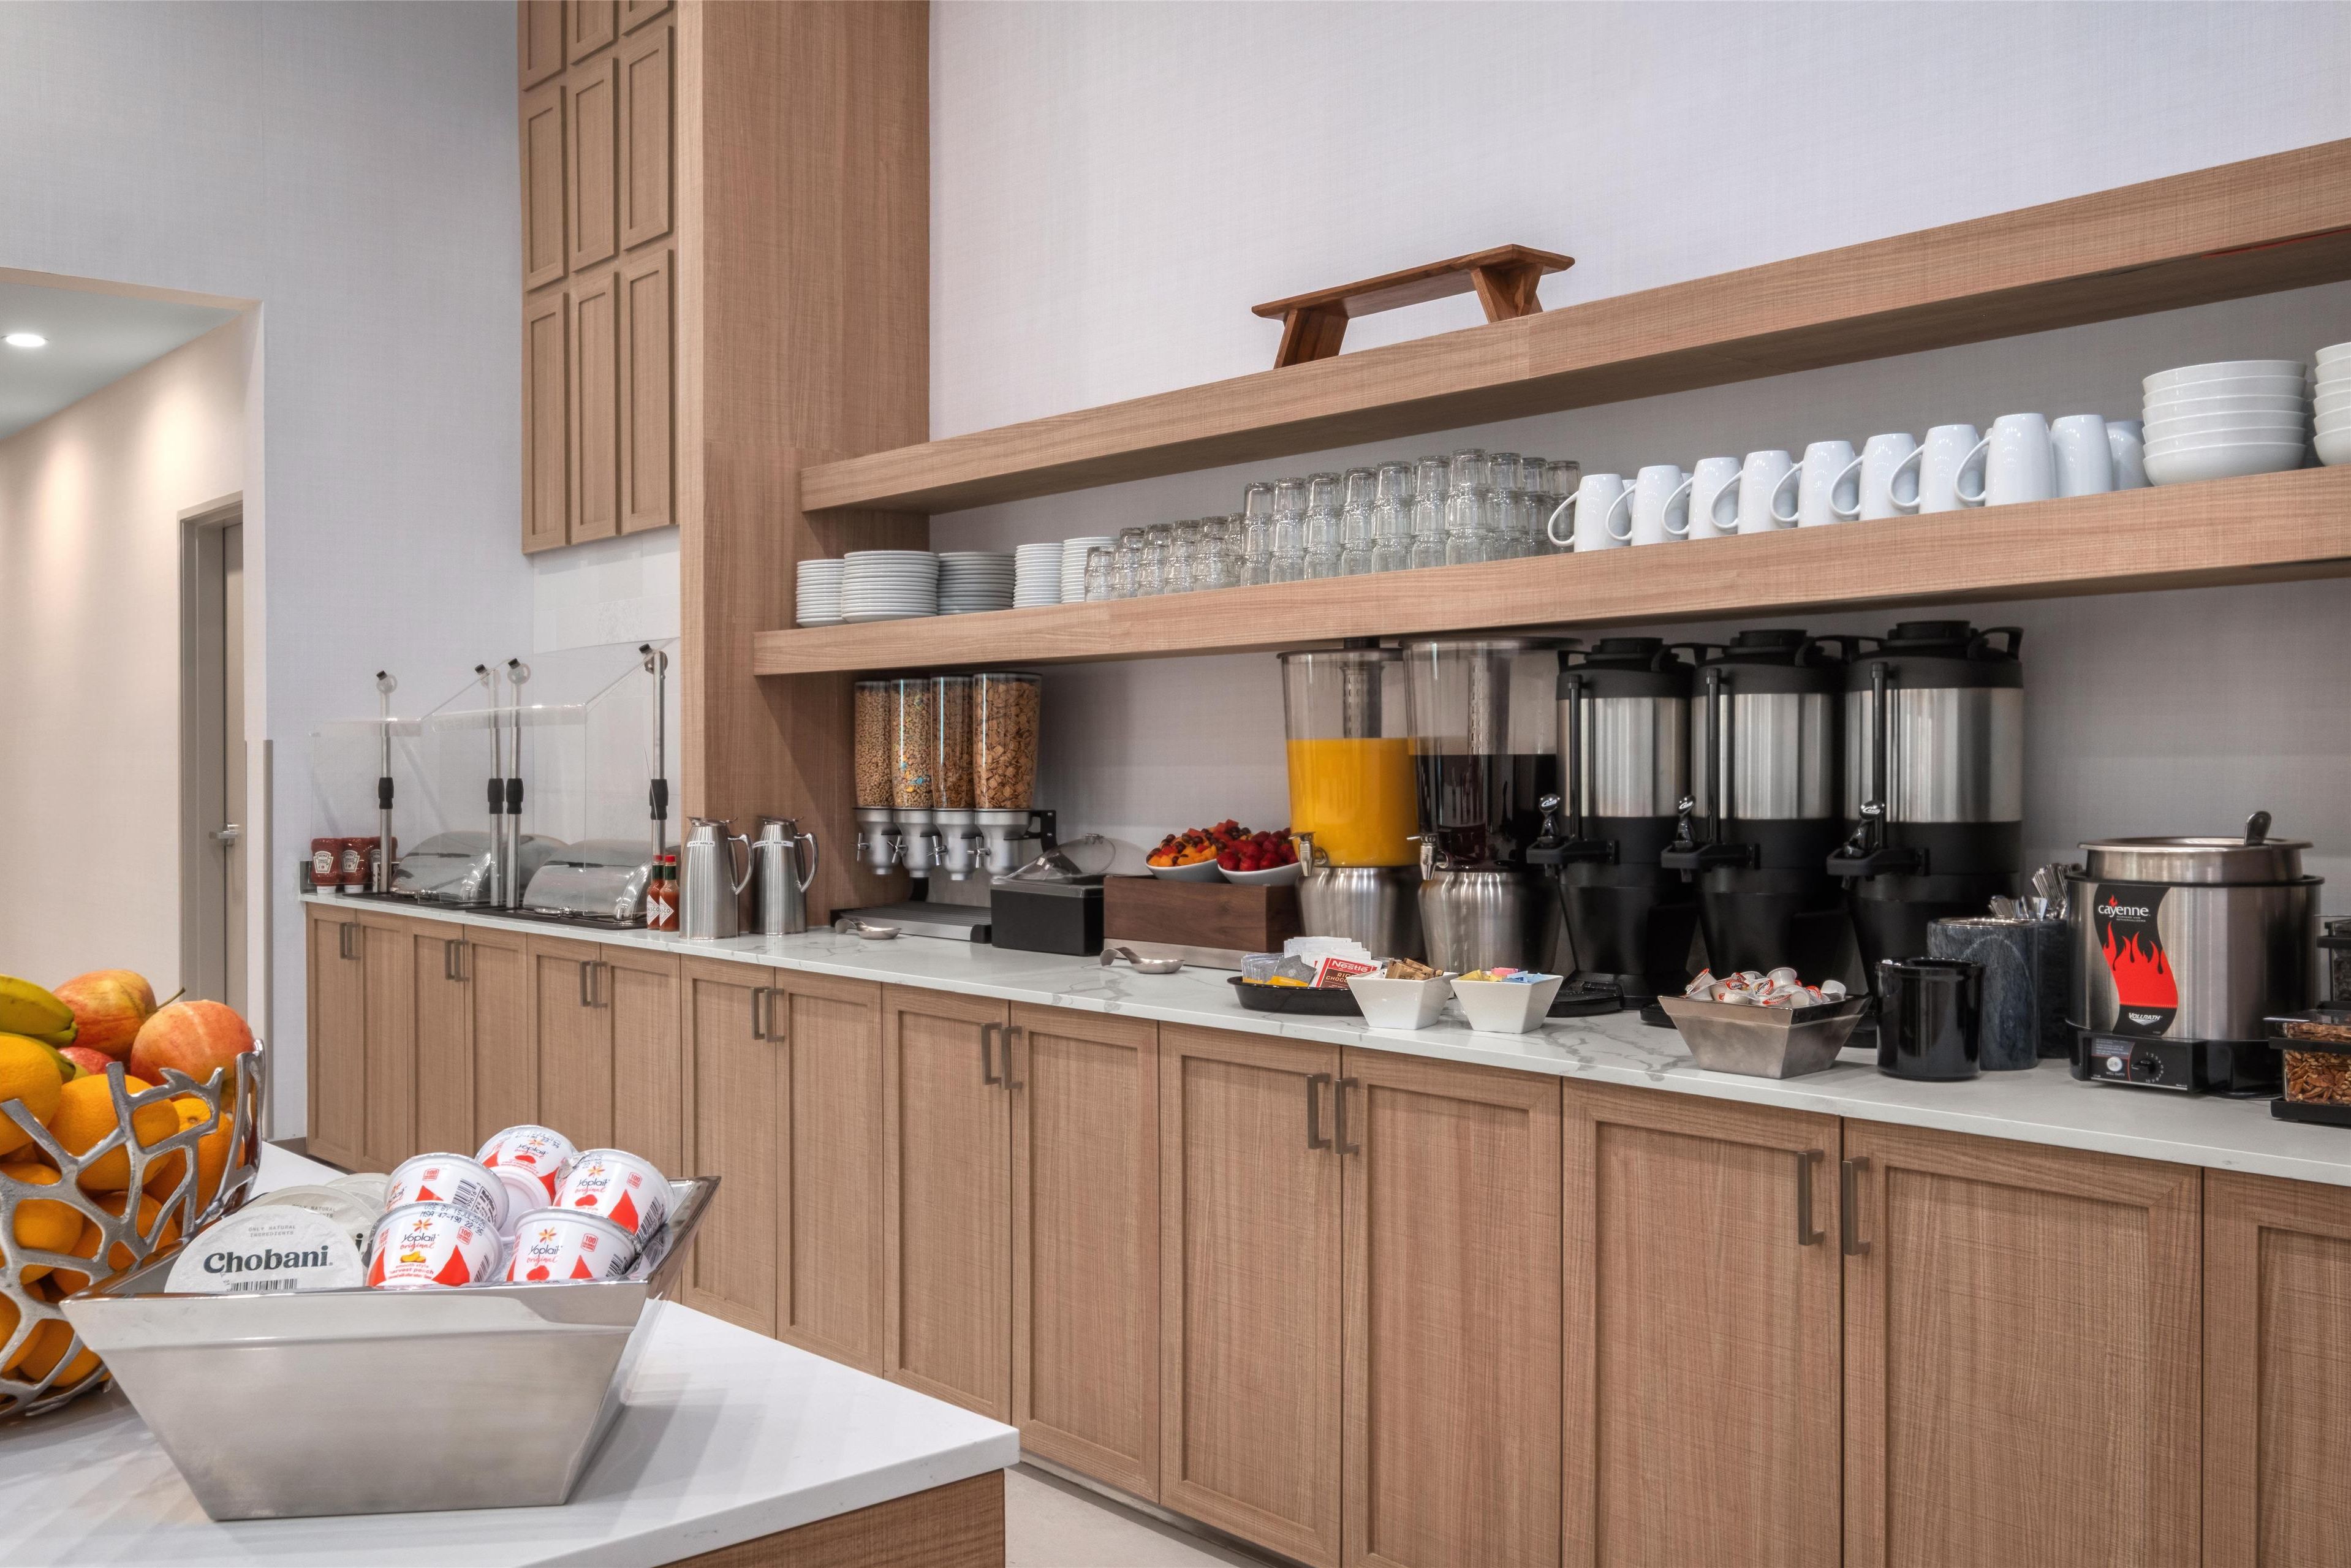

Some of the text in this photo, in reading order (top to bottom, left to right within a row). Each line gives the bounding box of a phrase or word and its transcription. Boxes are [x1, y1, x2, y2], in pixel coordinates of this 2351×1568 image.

[2098, 904, 2149, 917] cayenne
[518, 1144, 547, 1156] Yoplait
[577, 1178, 607, 1189] Yoplait
[630, 1173, 640, 1183] 100
[401, 1233, 436, 1243] Yoplait
[461, 1227, 471, 1238] 100
[585, 1235, 596, 1244] 100
[399, 1241, 435, 1252] original
[528, 1244, 560, 1256] Yoplait
[203, 1245, 329, 1273] Chobani
[526, 1256, 559, 1267] original
